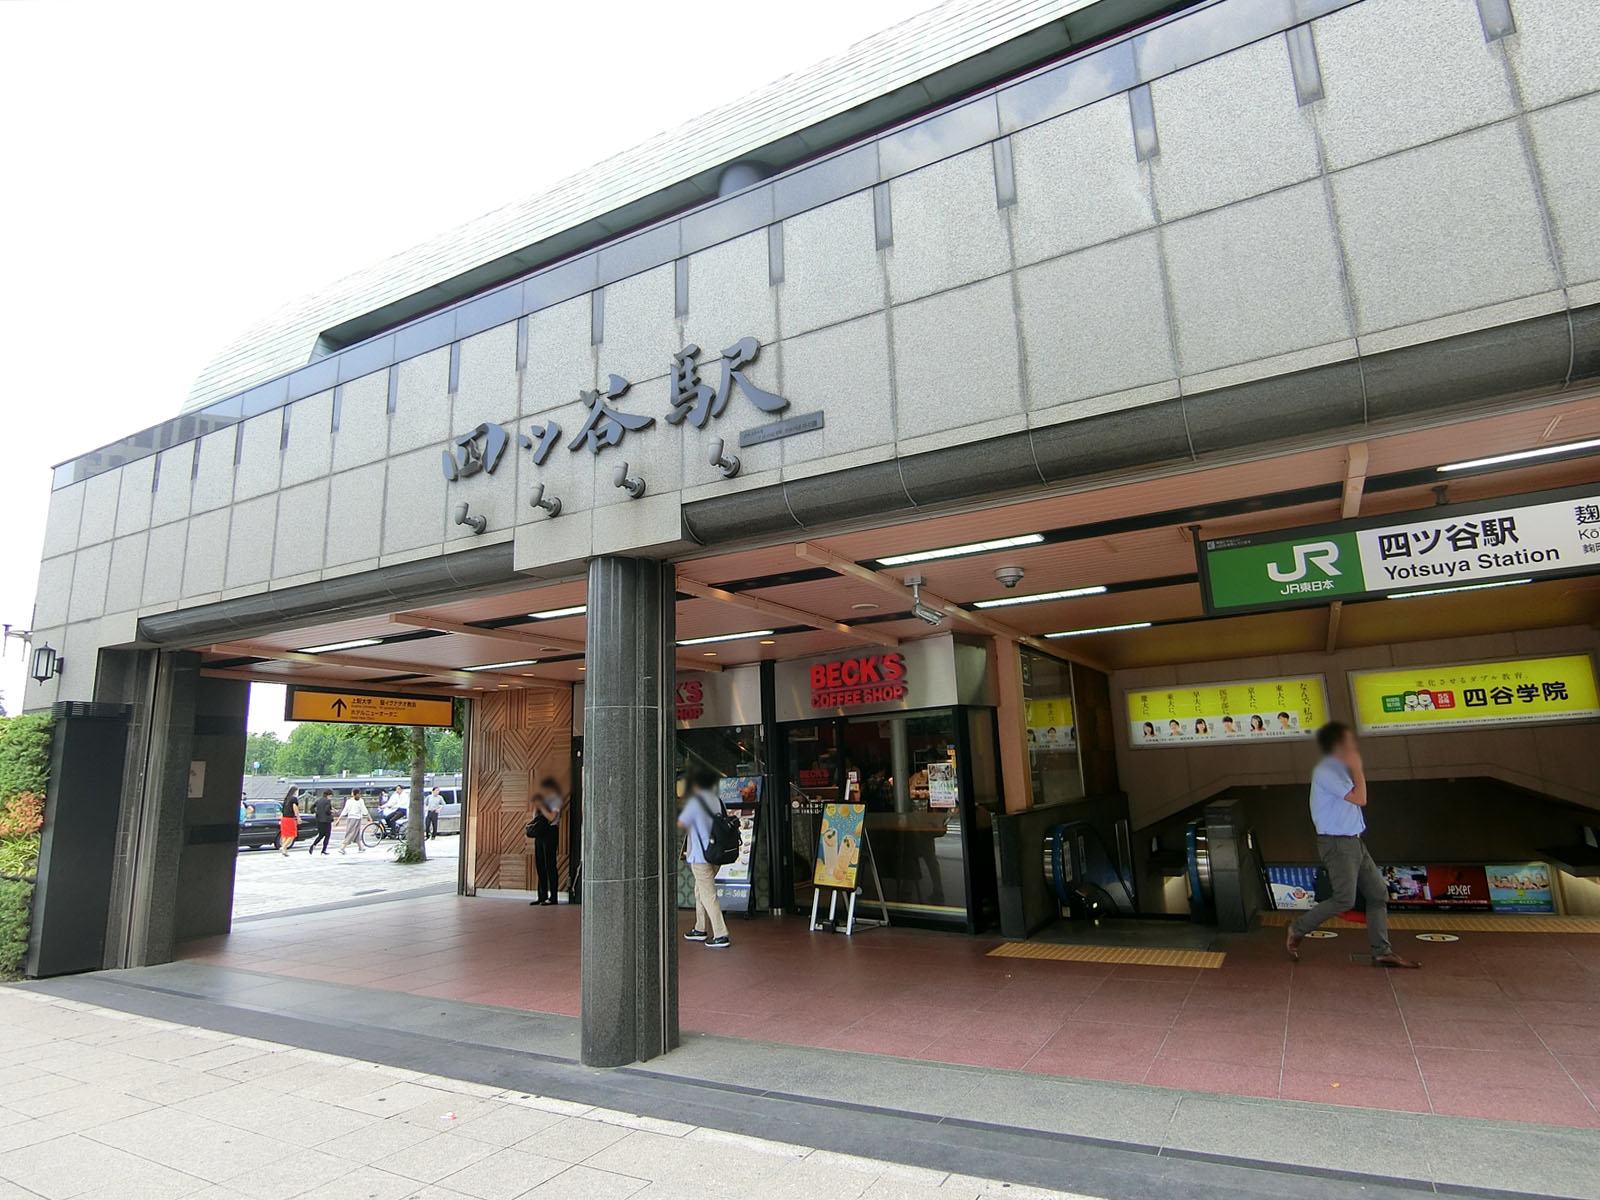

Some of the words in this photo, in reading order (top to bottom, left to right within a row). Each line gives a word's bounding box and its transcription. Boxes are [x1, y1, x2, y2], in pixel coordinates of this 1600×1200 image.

[442, 336, 791, 482] 四ツ谷駅
[1378, 516, 1519, 561] 四ツ谷駅
[1578, 528, 1600, 541] Kō
[1266, 541, 1343, 582] JR
[1384, 559, 1471, 581] Yotsuya
[1478, 548, 1560, 569] Station
[1280, 579, 1335, 595] JR東日本
[810, 653, 906, 689] BECK'S
[811, 689, 861, 708] COFFEE
[863, 685, 905, 703] SHOP
[1463, 681, 1569, 707] 四谷学院
